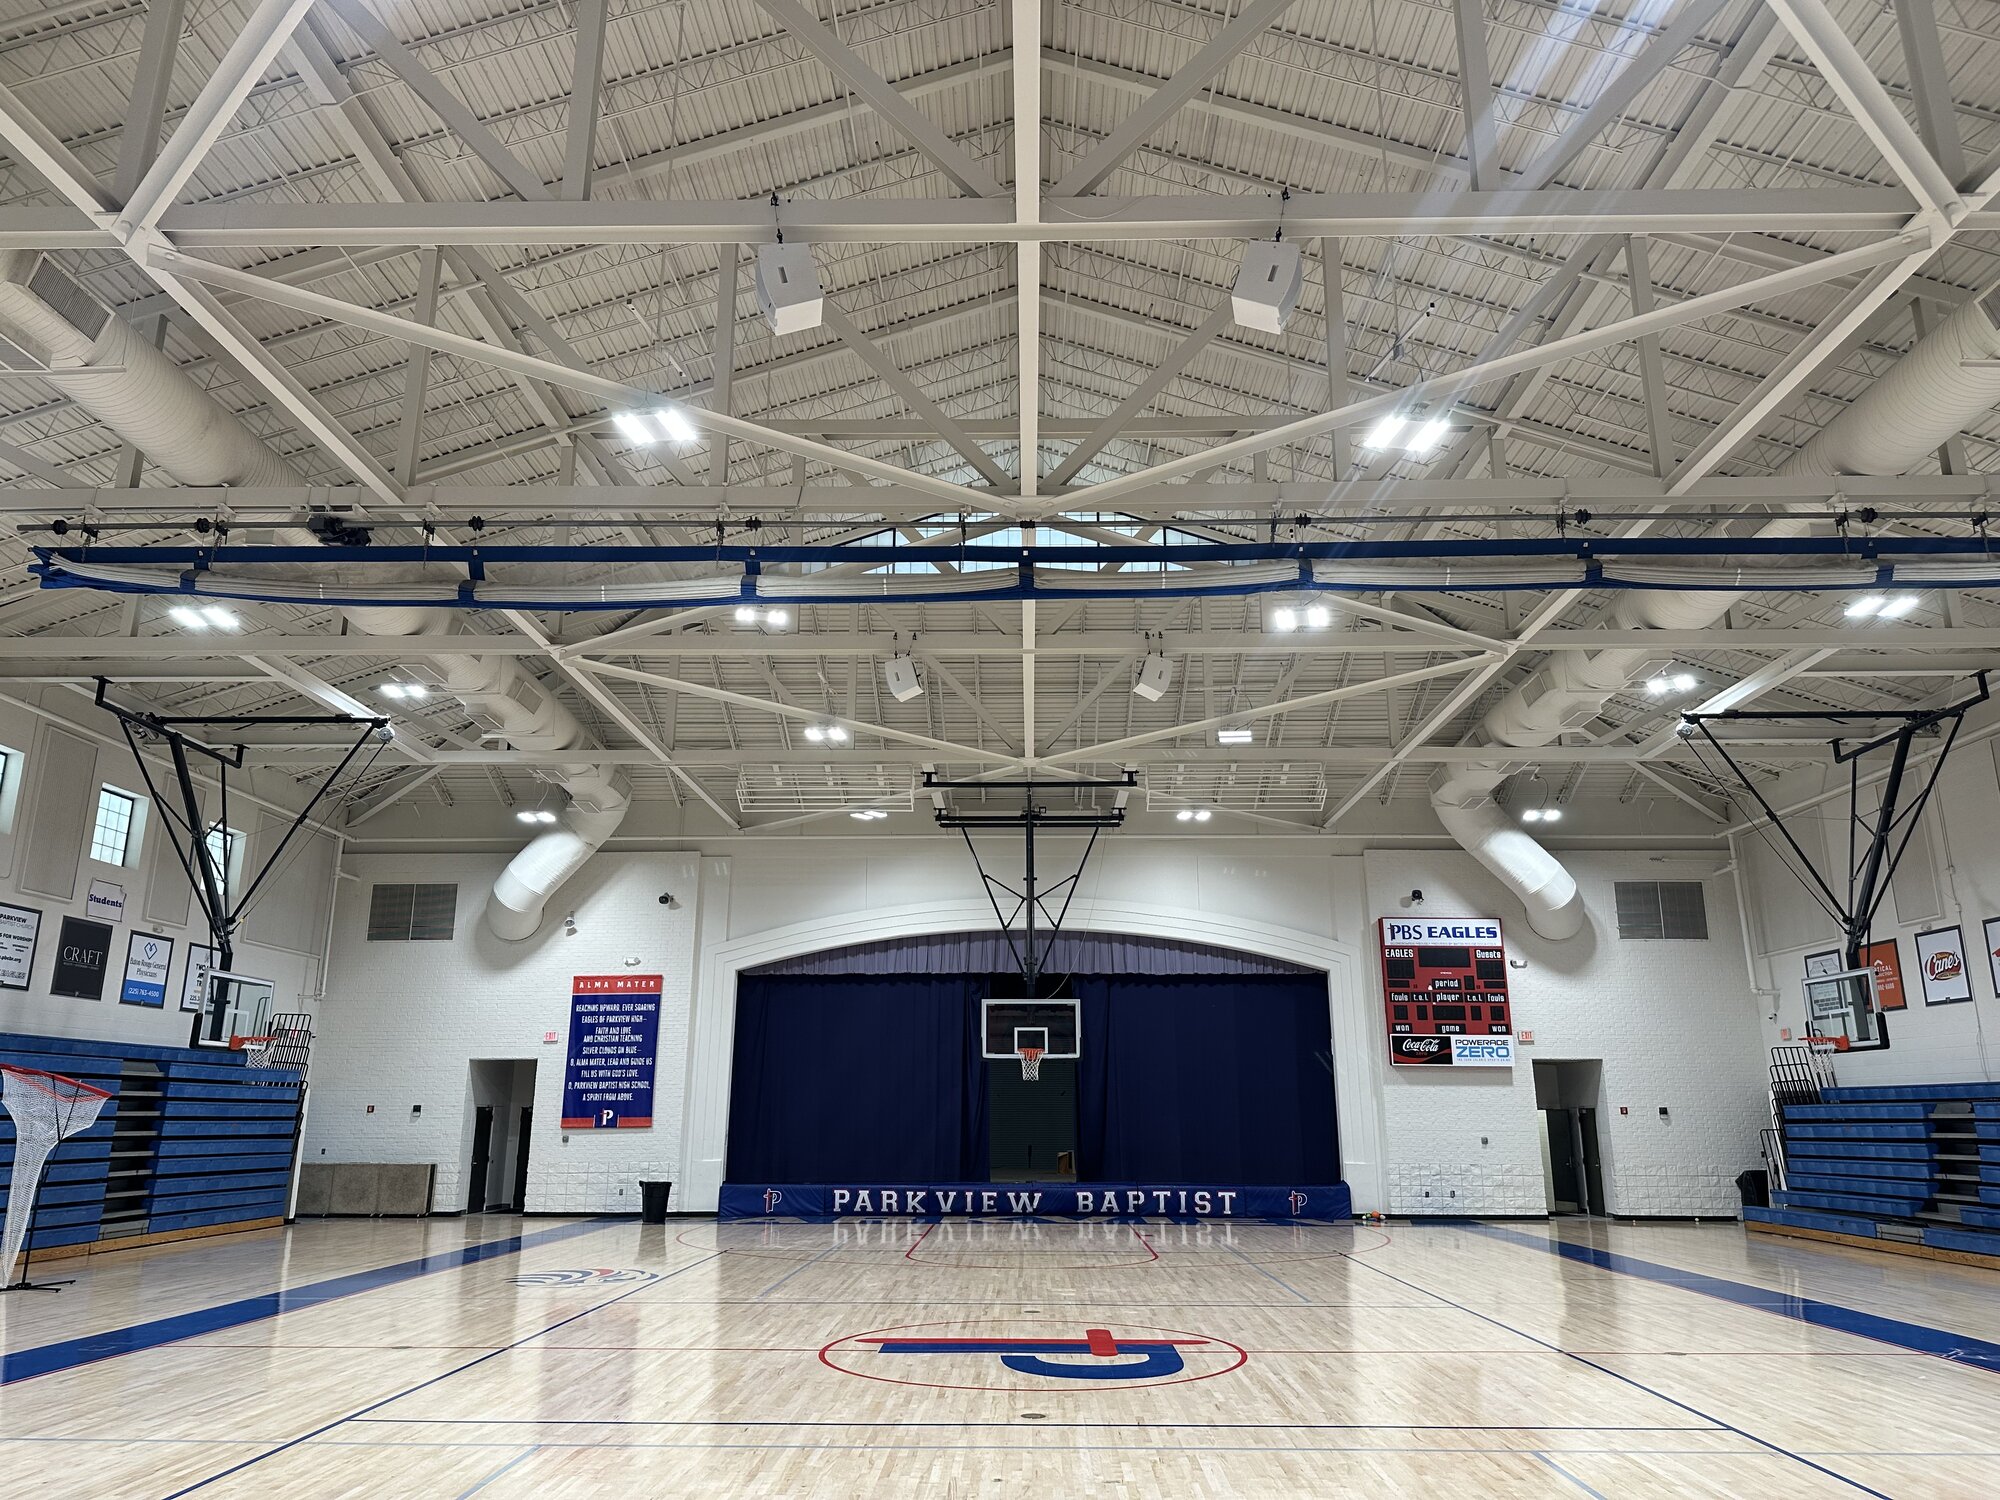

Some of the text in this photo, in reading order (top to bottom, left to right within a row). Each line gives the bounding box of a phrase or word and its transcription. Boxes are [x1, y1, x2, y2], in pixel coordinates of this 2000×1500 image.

[88, 894, 122, 908] Students
[0, 914, 28, 924] PARKVIEW
[1387, 923, 1498, 941] PBS EAGLES
[63, 945, 103, 966] CRAFT
[1385, 948, 1414, 958] EAGLES
[1476, 950, 1502, 959] Guests
[130, 958, 167, 971] Baton Rouge General
[1926, 951, 1960, 980] Cane's
[136, 967, 158, 978] Physicians
[617, 980, 655, 988] MATER
[1434, 980, 1459, 988] period
[1391, 992, 1408, 1002] fouls
[1436, 993, 1460, 1002] player
[1488, 994, 1505, 1002] fouls
[576, 1004, 599, 1012] REACHING
[634, 1003, 655, 1011] SOARING
[606, 1015, 630, 1023] PARKVIEW
[620, 1026, 631, 1034] LOVE
[1395, 1024, 1410, 1032] won
[1442, 1025, 1460, 1033] game
[545, 1032, 557, 1040] EXIT
[1402, 1038, 1441, 1052] Coca-Cola
[617, 1046, 624, 1054] ON
[1456, 1046, 1510, 1058] ZERO
[576, 1058, 588, 1066] ALMA
[589, 1058, 606, 1066] MATER,
[607, 1058, 619, 1066] LEAD
[581, 1070, 590, 1078] FILL
[591, 1070, 598, 1078] US
[574, 1082, 598, 1090] PARKVIEW
[603, 1093, 616, 1101] FROM
[834, 1190, 1238, 1214] PARKVIEW BAPTIST
